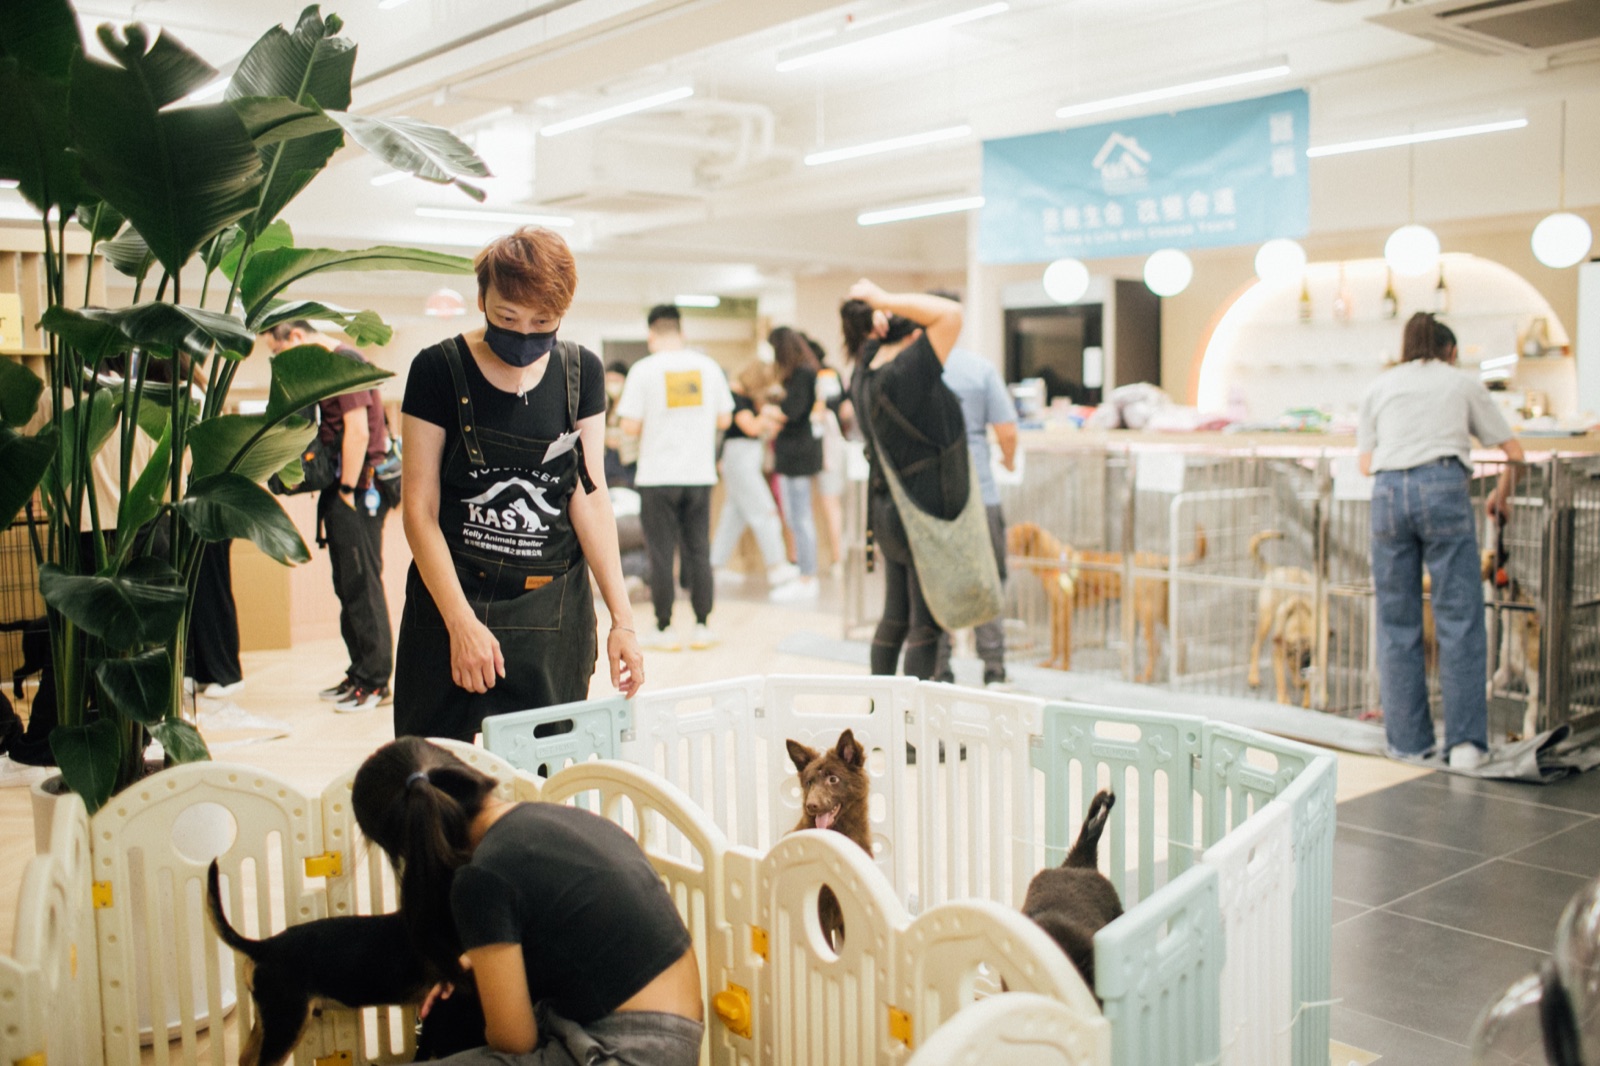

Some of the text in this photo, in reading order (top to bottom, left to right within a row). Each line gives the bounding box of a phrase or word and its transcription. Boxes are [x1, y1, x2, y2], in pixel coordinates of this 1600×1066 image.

[468, 503, 517, 531] KAS
[463, 528, 543, 547] Kelly Animals Shelter
